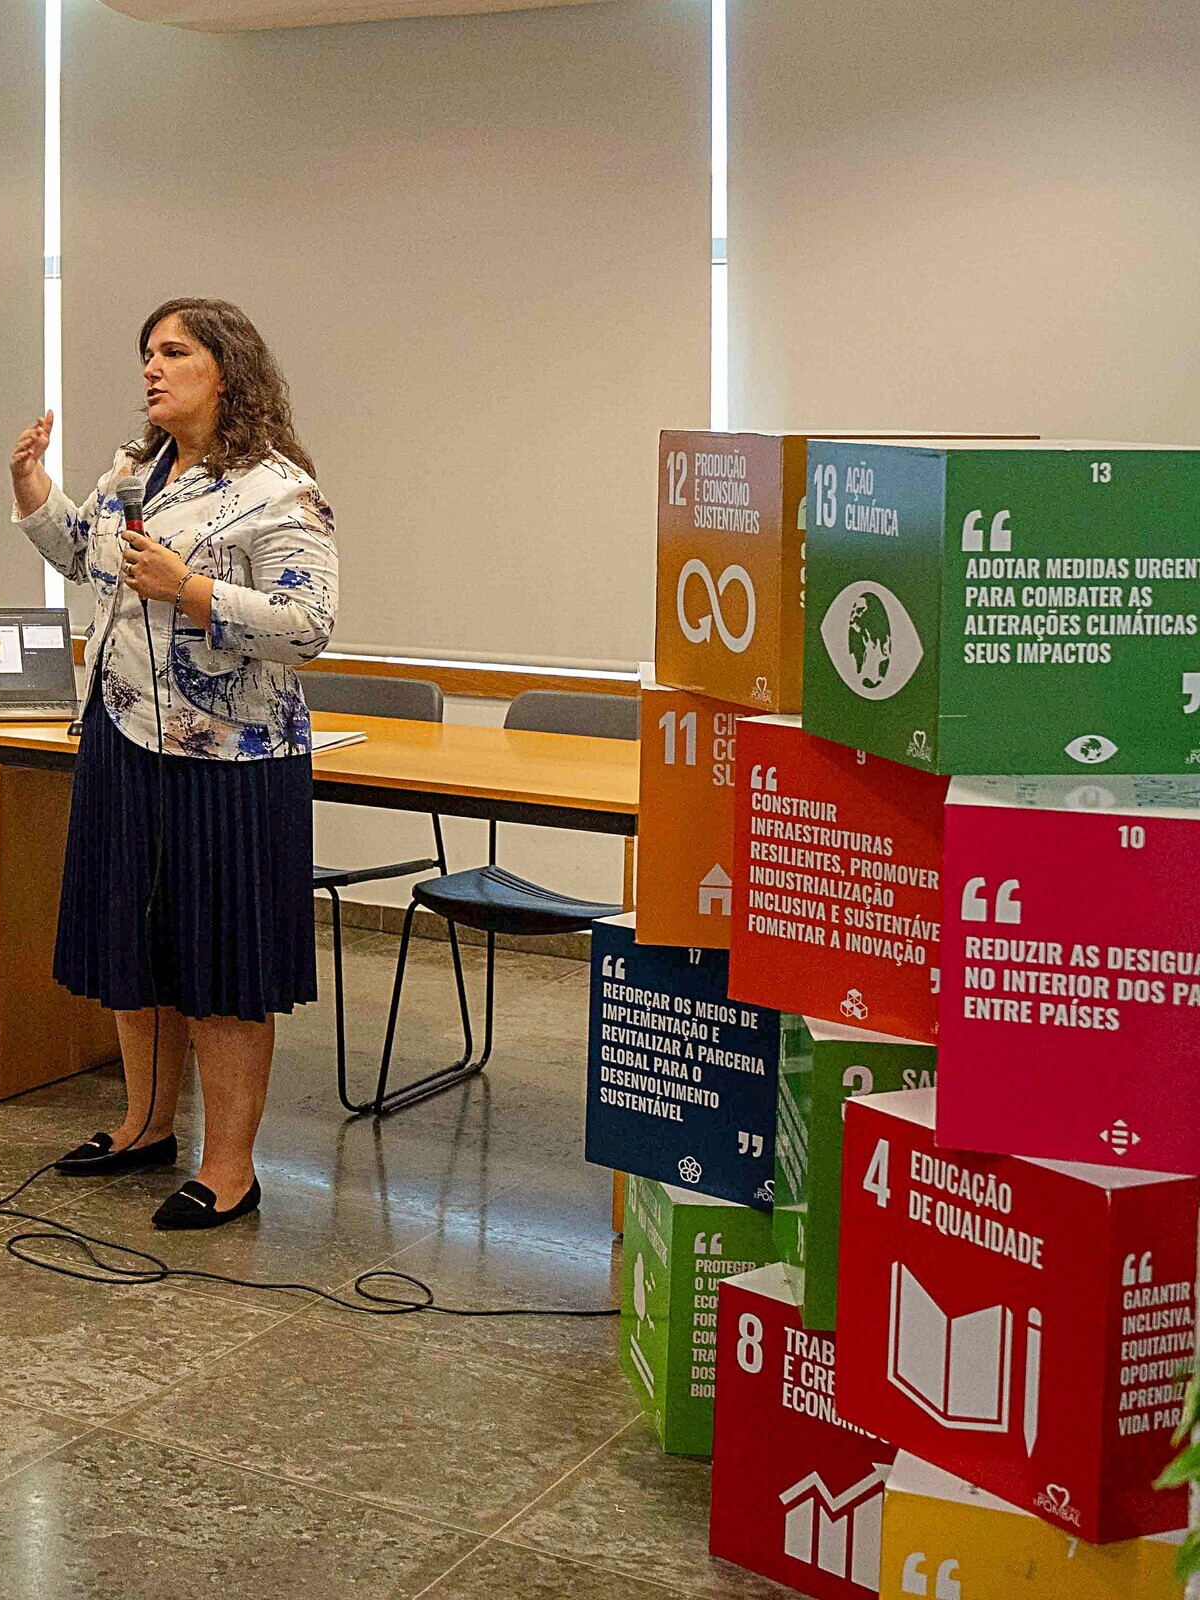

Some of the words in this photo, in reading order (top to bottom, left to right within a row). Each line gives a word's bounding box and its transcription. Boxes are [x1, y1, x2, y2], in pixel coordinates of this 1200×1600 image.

[667, 451, 688, 506] 12
[695, 449, 746, 482] PRODUÇÃO
[846, 461, 873, 501] AÇÃO
[1090, 462, 1112, 483] 13
[695, 478, 700, 501] E
[703, 479, 750, 506] CONSUMO
[814, 464, 837, 528] 13
[694, 504, 760, 534] SUSTENTÁVEIS
[845, 498, 898, 537] CLIMÁTICA
[965, 558, 1040, 579] ADOTAR
[1046, 558, 1129, 579] MEDIDAS
[965, 586, 1015, 607] PARA
[1022, 586, 1122, 607] COMBATER
[1128, 586, 1152, 607] AS
[964, 610, 1081, 641] ALTERAÇÕES
[1086, 609, 1197, 635] CLIMÁTICAS
[964, 643, 1010, 663] SEUS
[1017, 643, 1111, 663] IMPACTOS
[659, 711, 697, 766] 11
[751, 793, 837, 822] CONSTRUIR
[751, 816, 893, 856] INFRAESTRUTURAS
[1118, 825, 1145, 849] 10
[751, 841, 844, 876] RESILIENTES,
[850, 858, 939, 890] PROMOVER
[750, 865, 894, 909] INDUSTRIALIZAÇÃO
[749, 890, 826, 921] INCLUSIVA
[831, 905, 839, 923] E
[688, 948, 702, 965] 17
[748, 914, 825, 946] FOMENTAR
[830, 930, 840, 949] A
[846, 933, 925, 966] INOVAÇÃO
[966, 936, 1062, 965] REDUZIR
[1070, 944, 1100, 968] AS
[964, 966, 995, 990] NO
[1003, 969, 1109, 1000] INTERIOR
[1117, 978, 1165, 1004] DOS
[602, 1003, 708, 1040] IMPLEMENTAÇÃO
[712, 1027, 720, 1043] E
[603, 982, 670, 1011] REFORÇAR
[674, 997, 691, 1015] OS
[696, 1001, 737, 1025] MEIOS
[741, 1010, 758, 1029] DE
[964, 996, 1032, 1023] ENTRE
[1039, 999, 1120, 1031] PAÍSES
[601, 1045, 649, 1071] GLOBAL
[654, 1057, 688, 1081] PARA
[693, 1067, 702, 1082] O
[602, 1024, 681, 1056] REVITALIZAR
[685, 1043, 694, 1059] A
[698, 1045, 765, 1076] PARCERIA
[600, 1087, 684, 1122] SUSTENTÁVEL
[601, 1066, 719, 1109] DESENVOLVIMENTO
[863, 1138, 891, 1208] 4
[911, 1150, 1012, 1214] EDUCAÇÃO
[909, 1190, 933, 1226] DE
[935, 1201, 1044, 1270] QUALIDADE
[695, 1277, 703, 1291] O
[1123, 1281, 1190, 1310] GARANTIR
[737, 1313, 763, 1373] 8
[1121, 1331, 1195, 1361] EQUITATIVA
[691, 1366, 715, 1380] DOS
[784, 1355, 794, 1381] E
[1118, 1414, 1150, 1436] VIDA
[1066, 1536, 1078, 1559] 7
